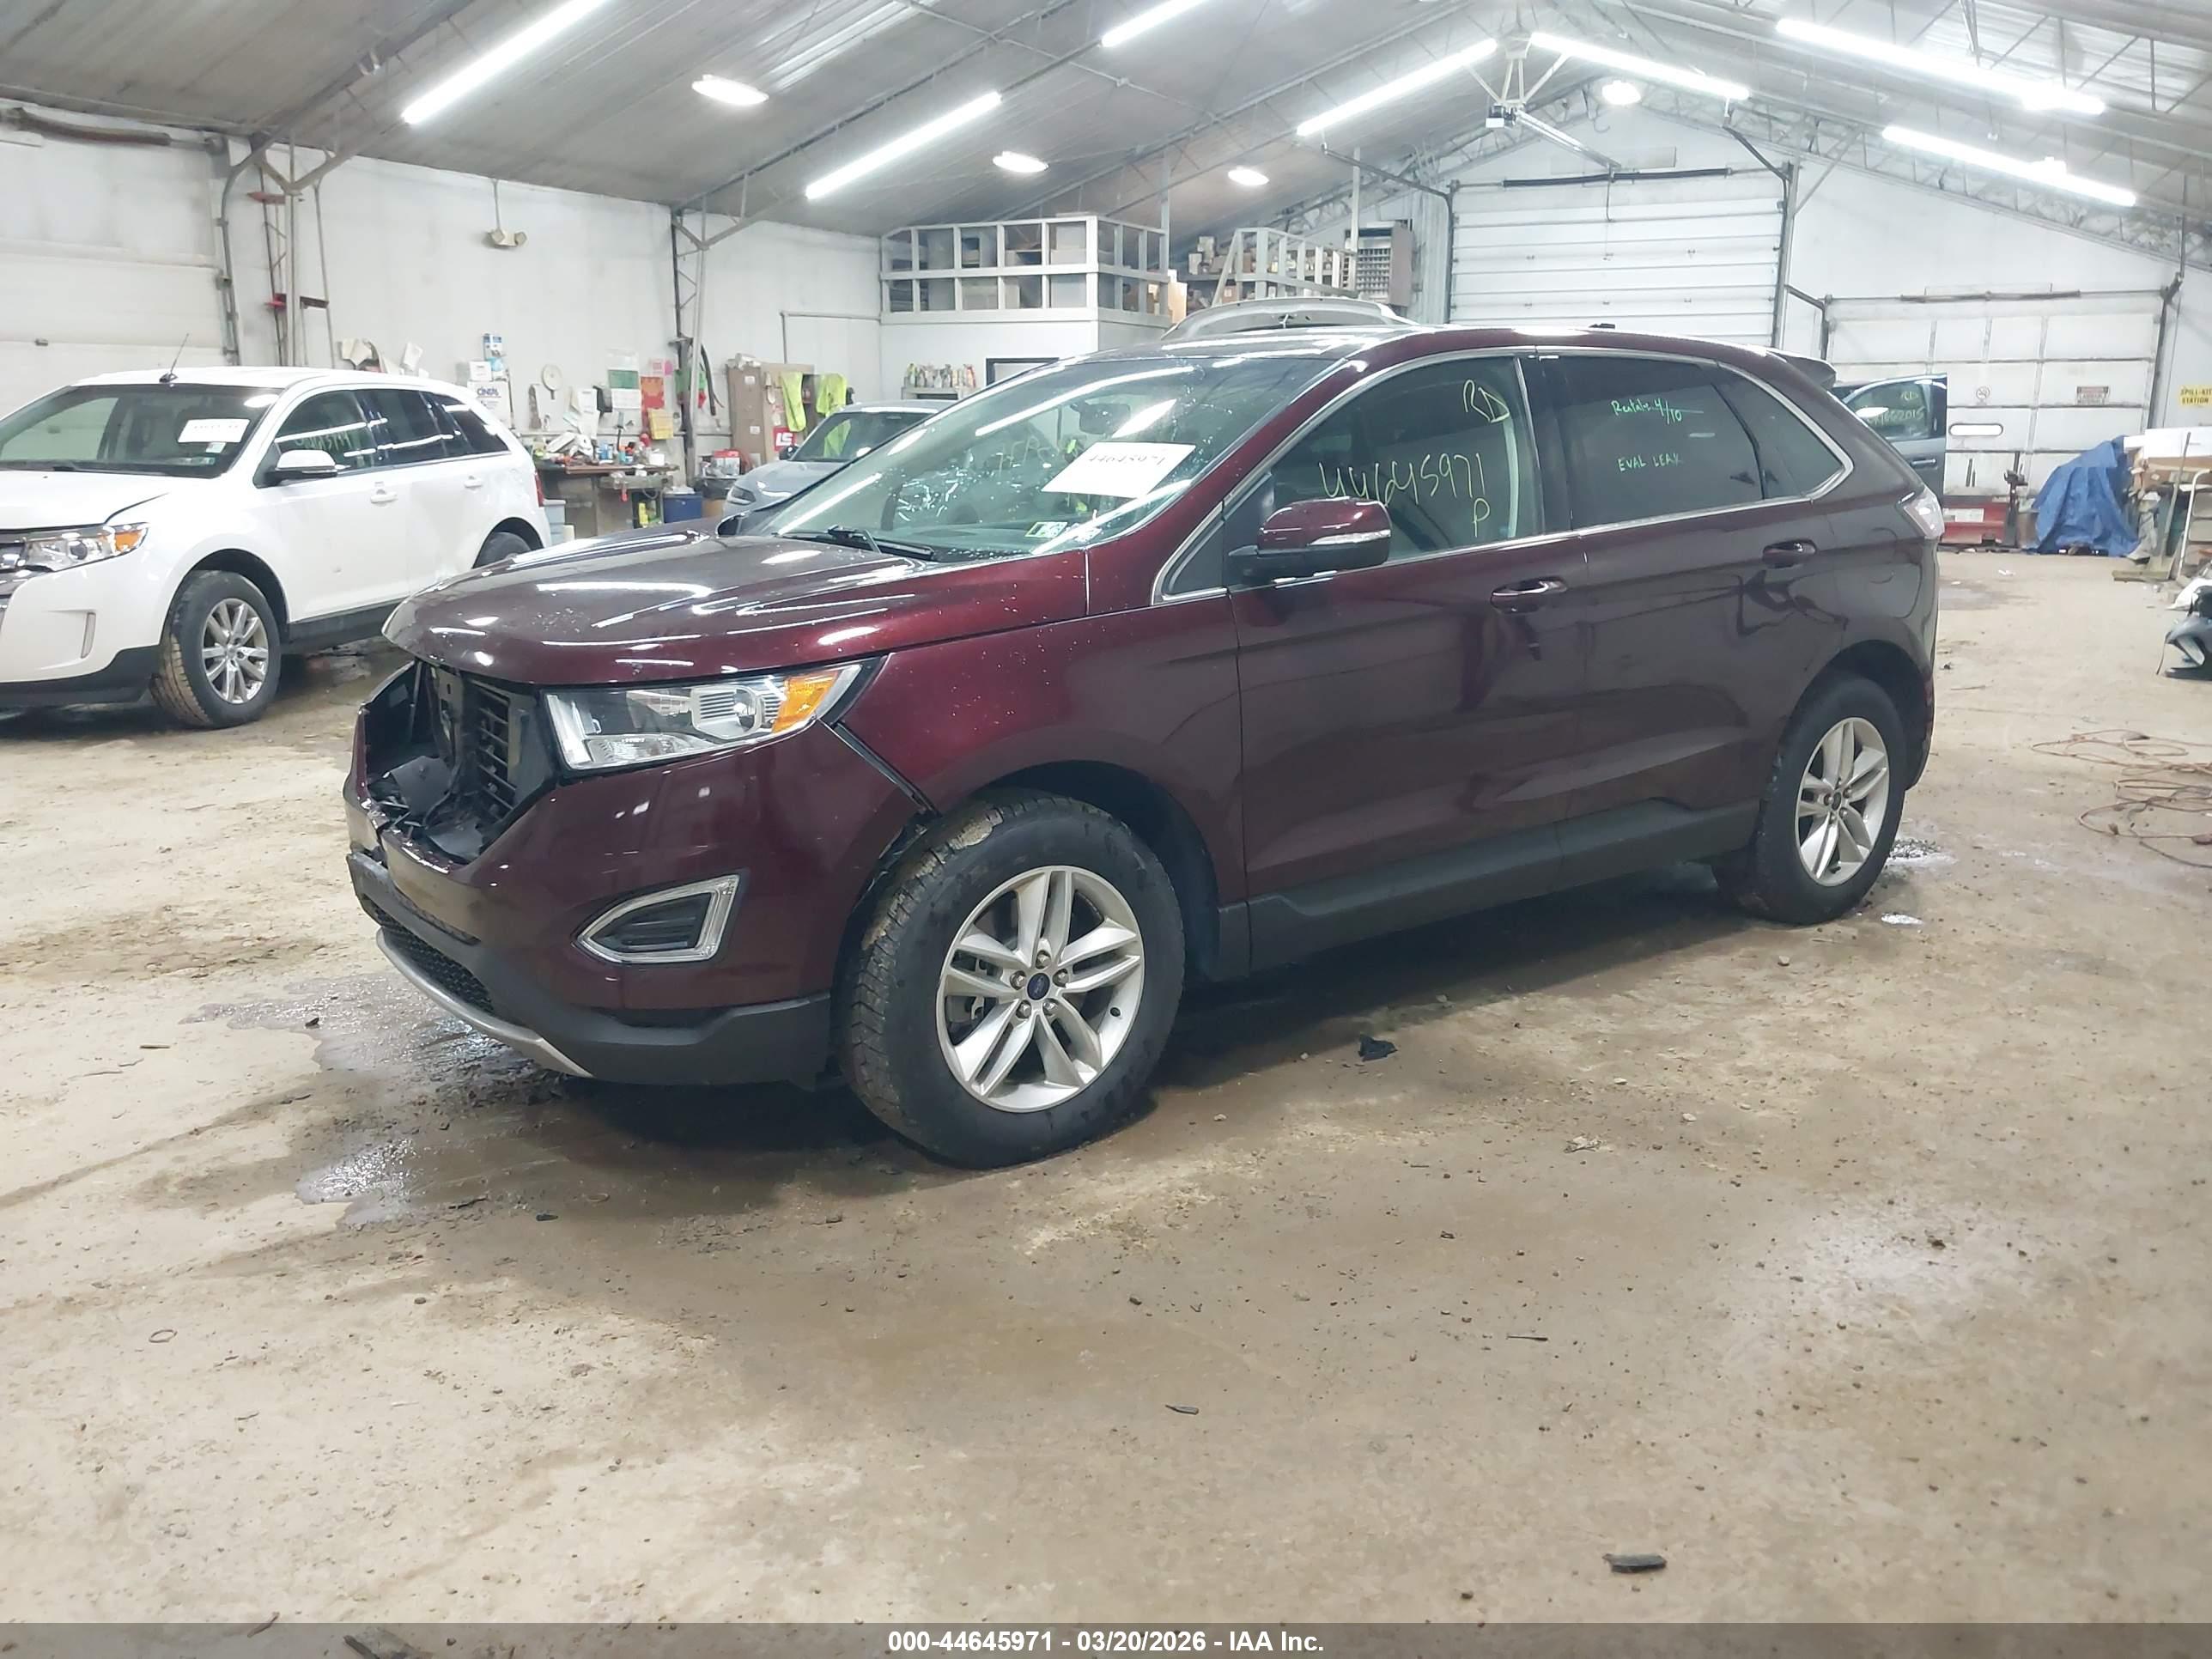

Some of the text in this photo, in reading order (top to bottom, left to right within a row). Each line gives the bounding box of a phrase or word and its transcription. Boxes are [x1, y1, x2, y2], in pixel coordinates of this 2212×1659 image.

[1318, 453, 1486, 507] 44645971
[1617, 454, 1647, 471] EVAL
[1473, 497, 1491, 538] P
